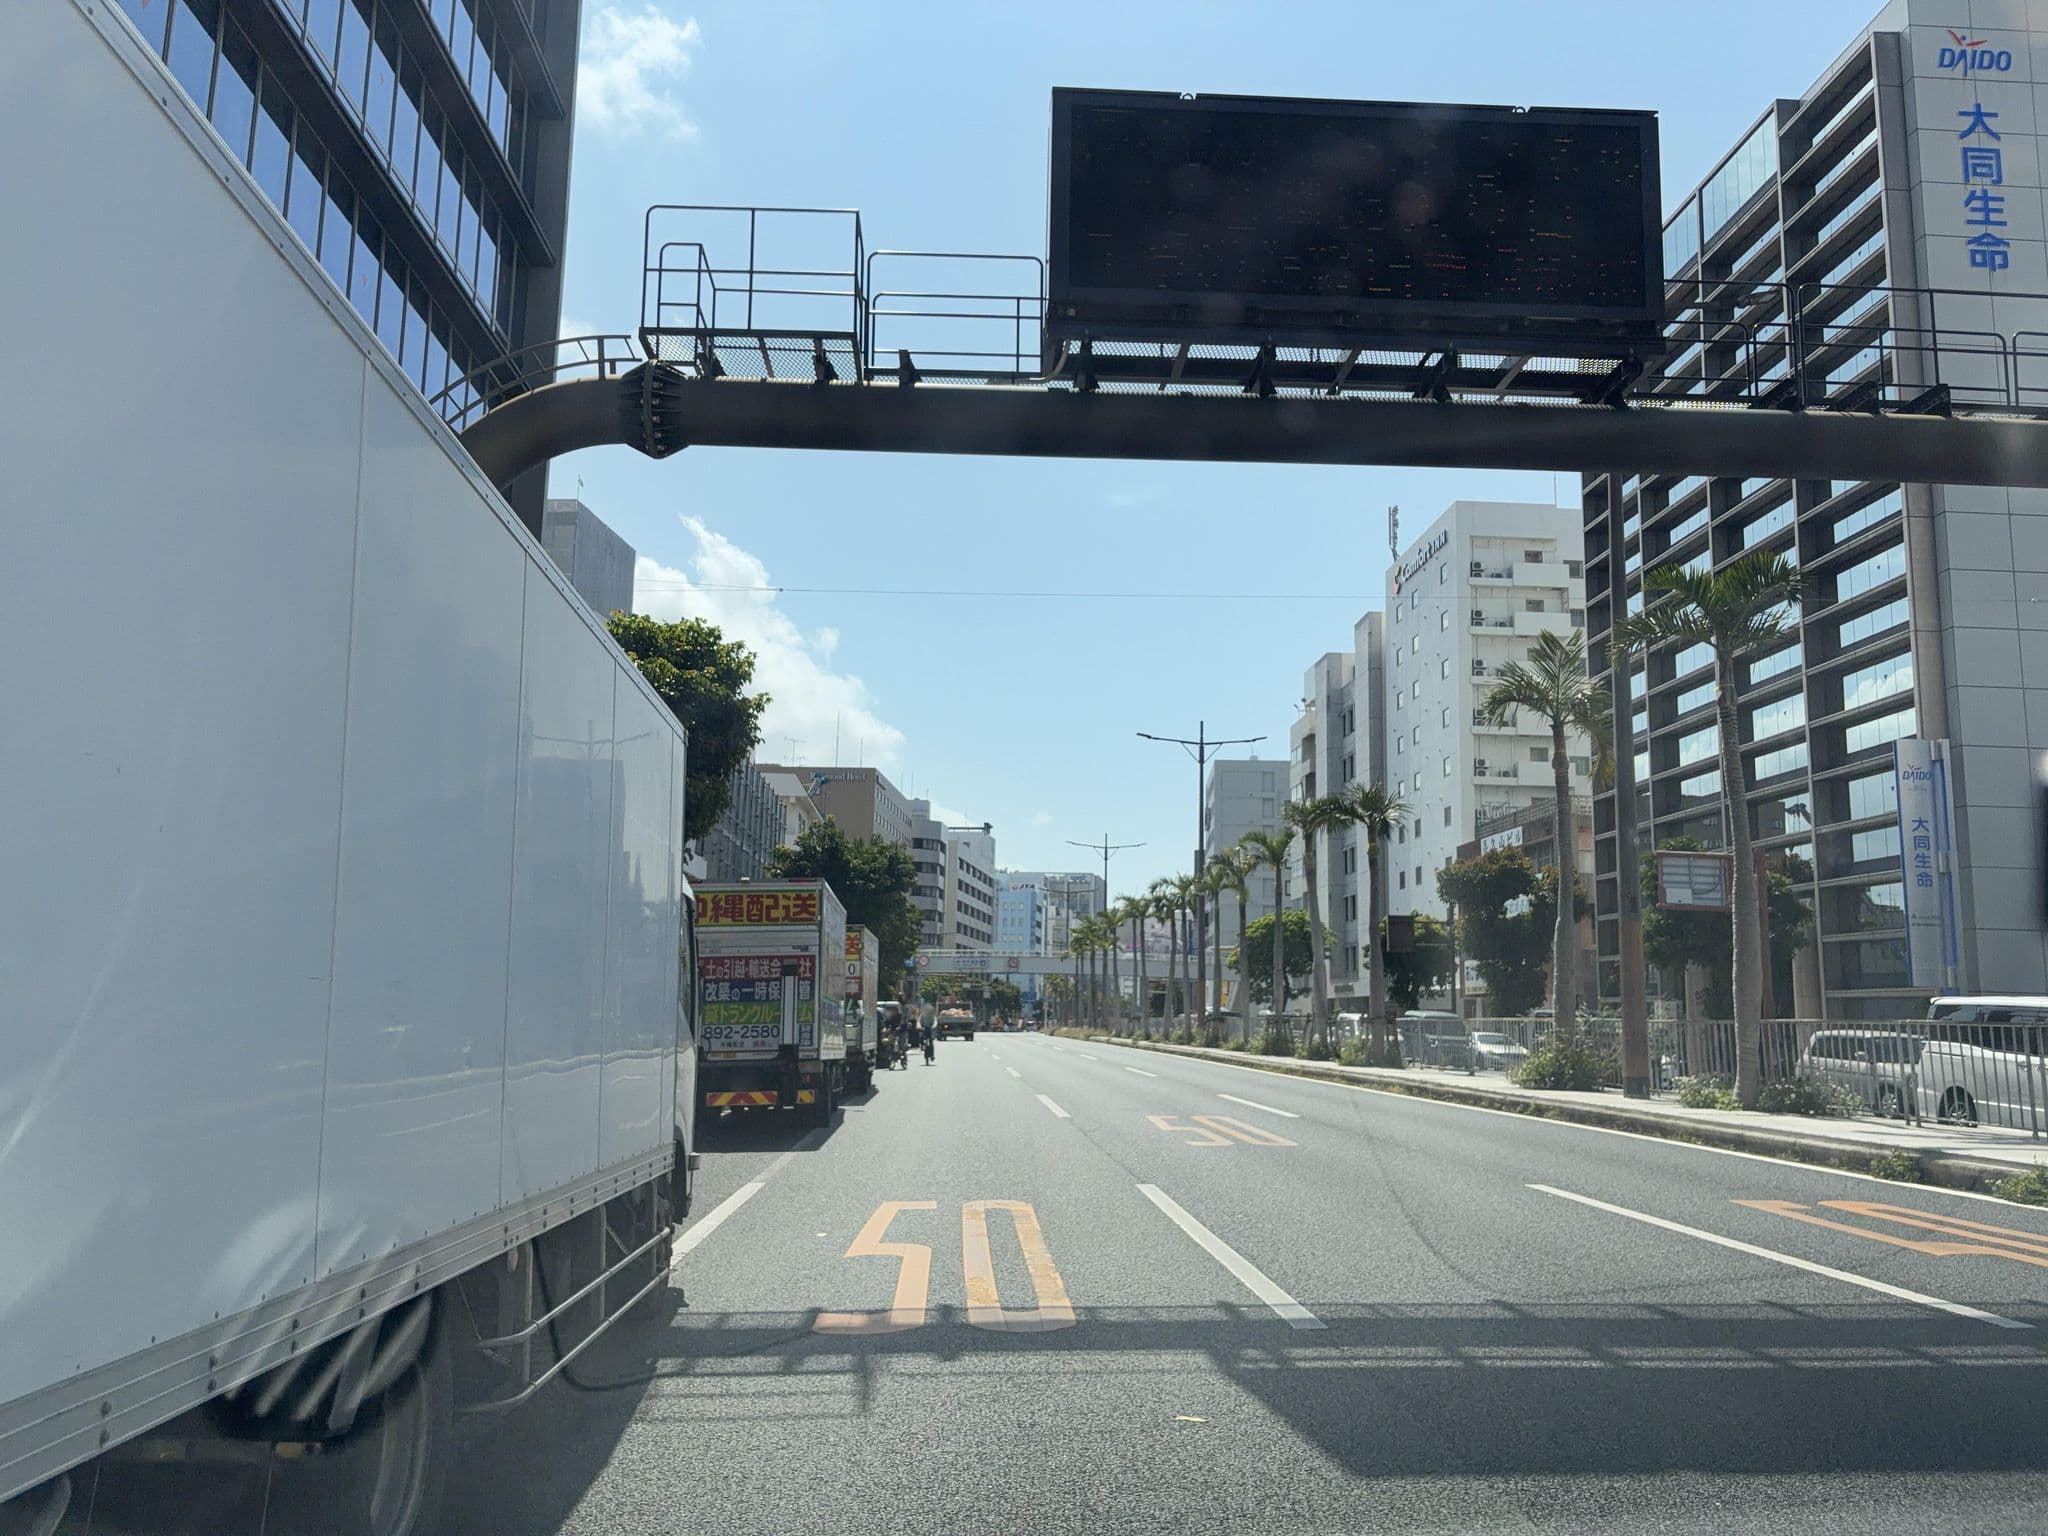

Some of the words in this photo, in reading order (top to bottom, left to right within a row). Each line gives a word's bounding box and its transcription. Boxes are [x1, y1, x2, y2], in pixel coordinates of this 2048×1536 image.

[1938, 47, 2012, 77] DAIDO
[1957, 102, 2011, 272] 大同生命
[1903, 770, 1933, 783] DAIDO
[1912, 816, 1933, 888] 大同生命
[703, 1025, 780, 1040] 892-2580
[1146, 1114, 1299, 1148] 50
[812, 1198, 1078, 1335] 50
